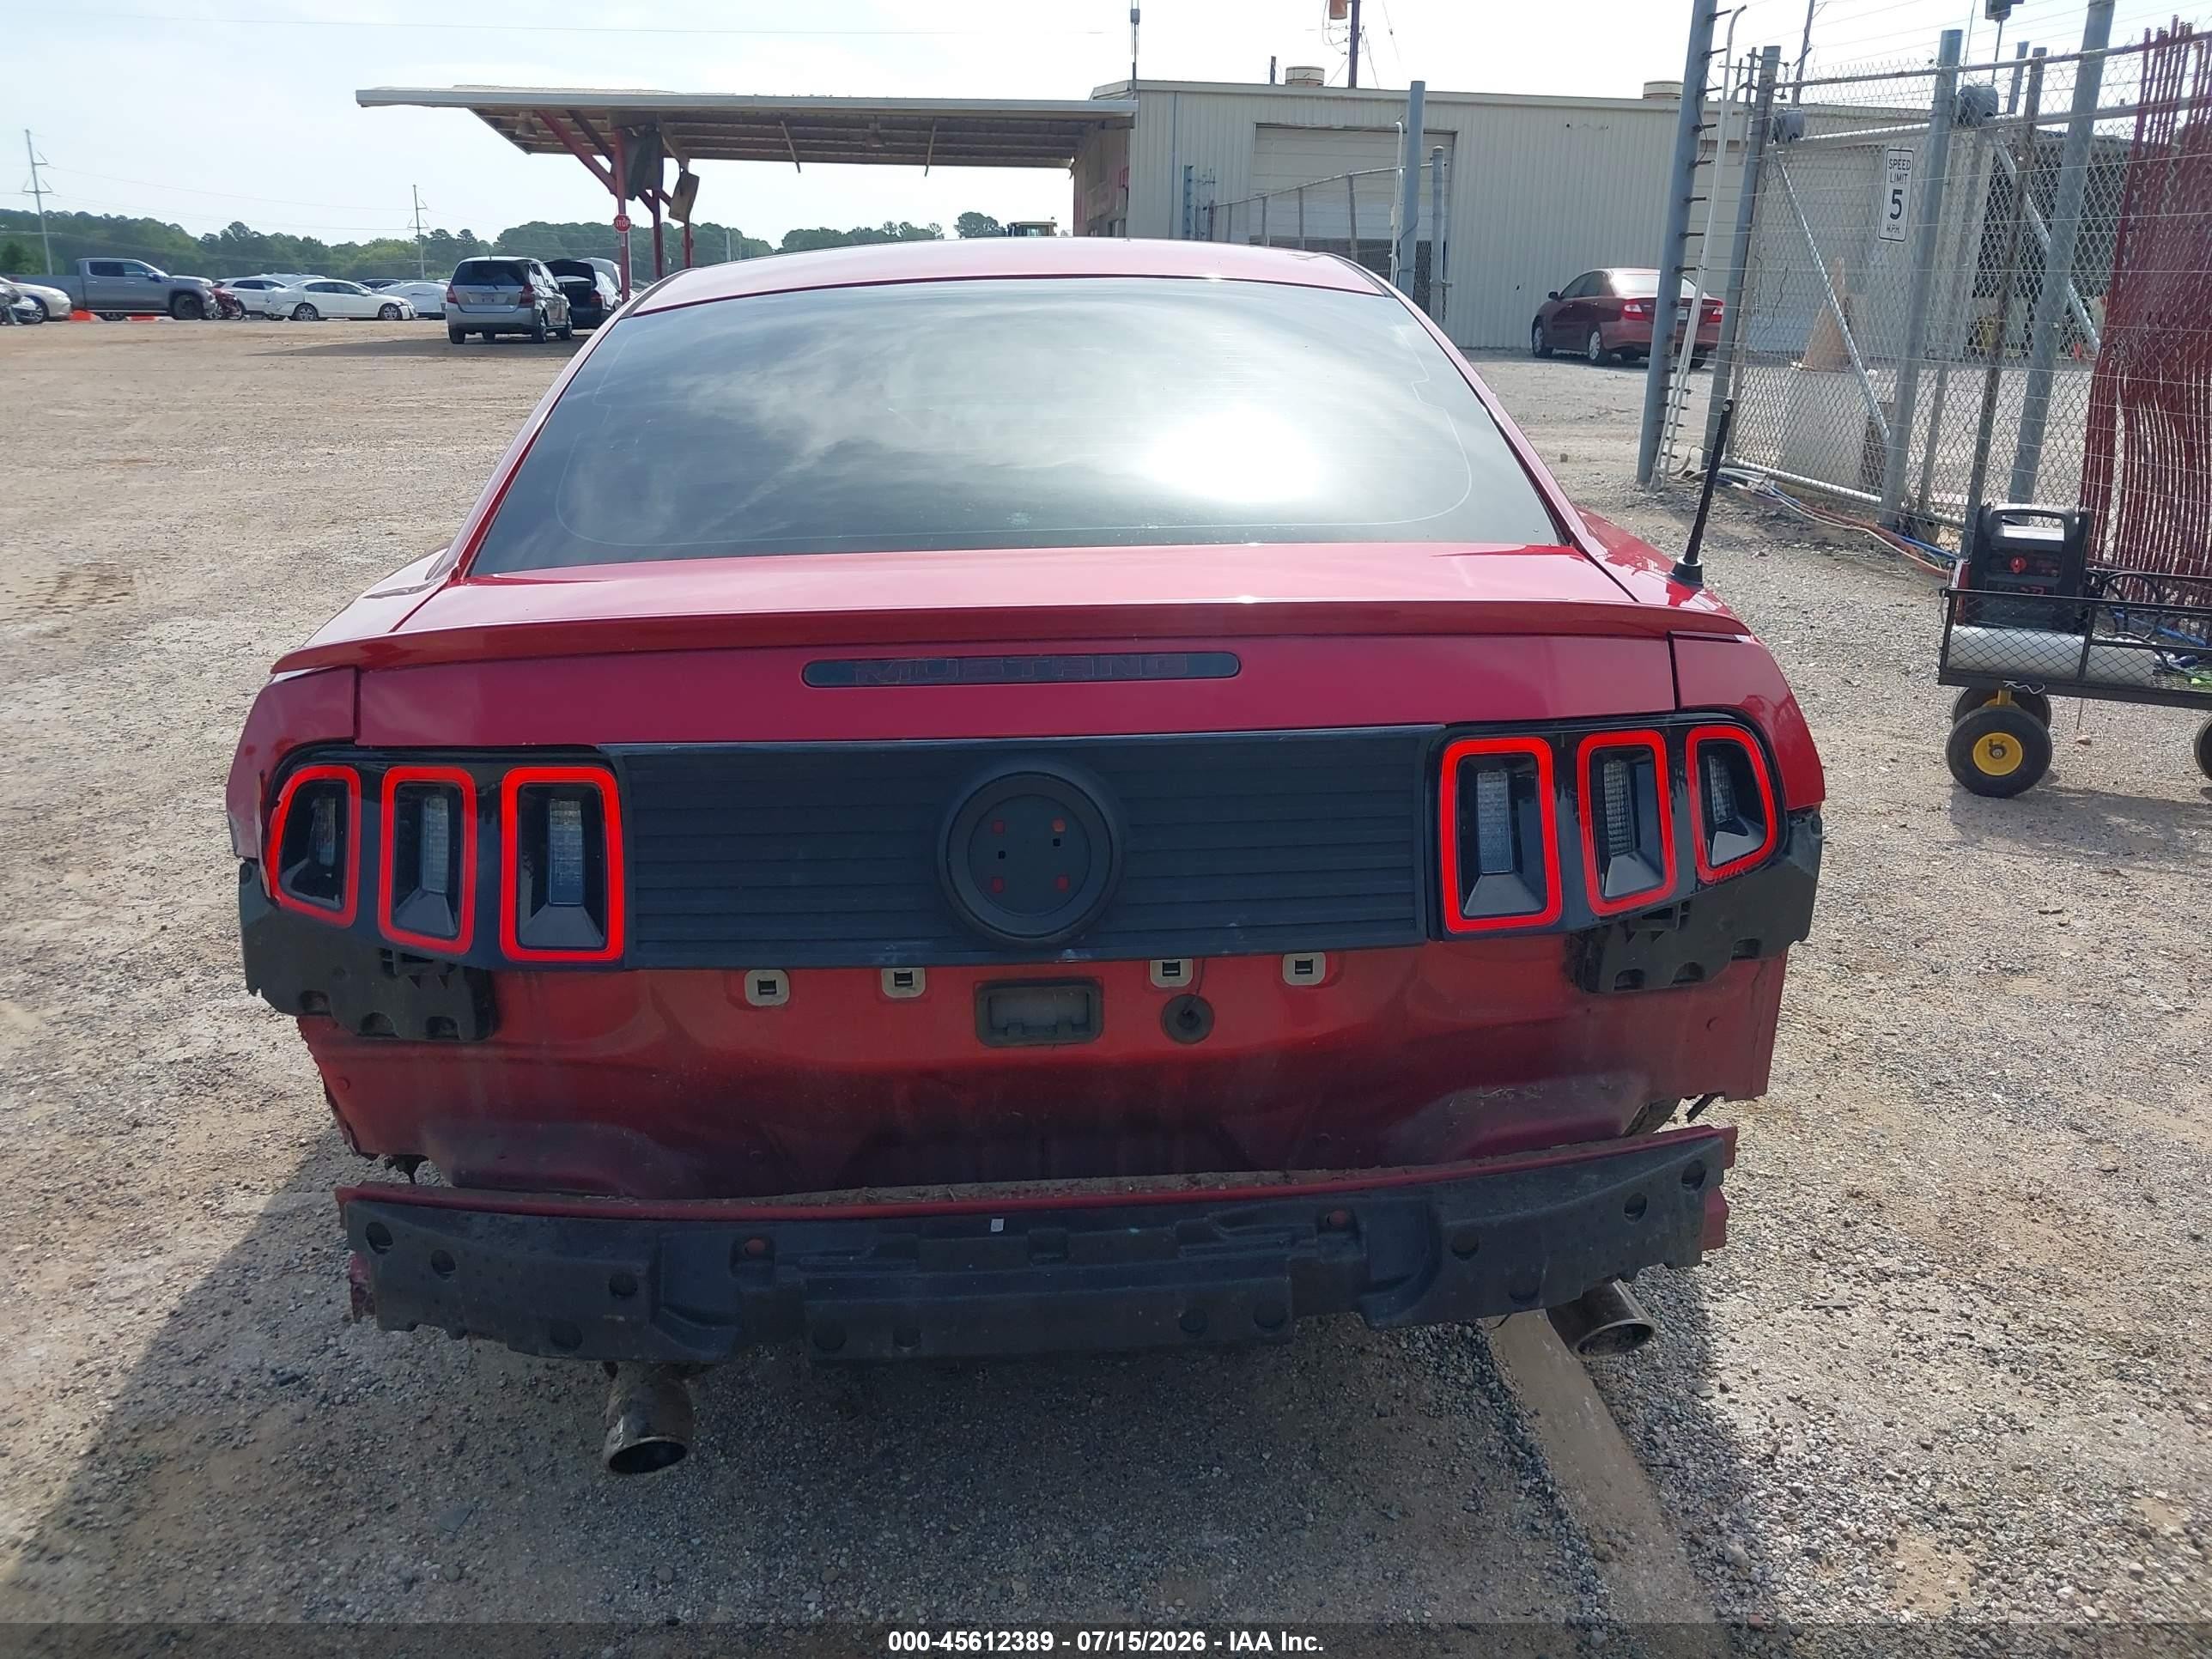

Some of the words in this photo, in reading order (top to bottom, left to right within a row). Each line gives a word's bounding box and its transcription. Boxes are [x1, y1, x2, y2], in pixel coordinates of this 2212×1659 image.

[1888, 159, 1911, 171] SPEED
[1889, 173, 1908, 185] LIMIT
[1890, 189, 1902, 220] 5
[614, 218, 630, 228] STOP
[854, 654, 1188, 685] MUSTANG
